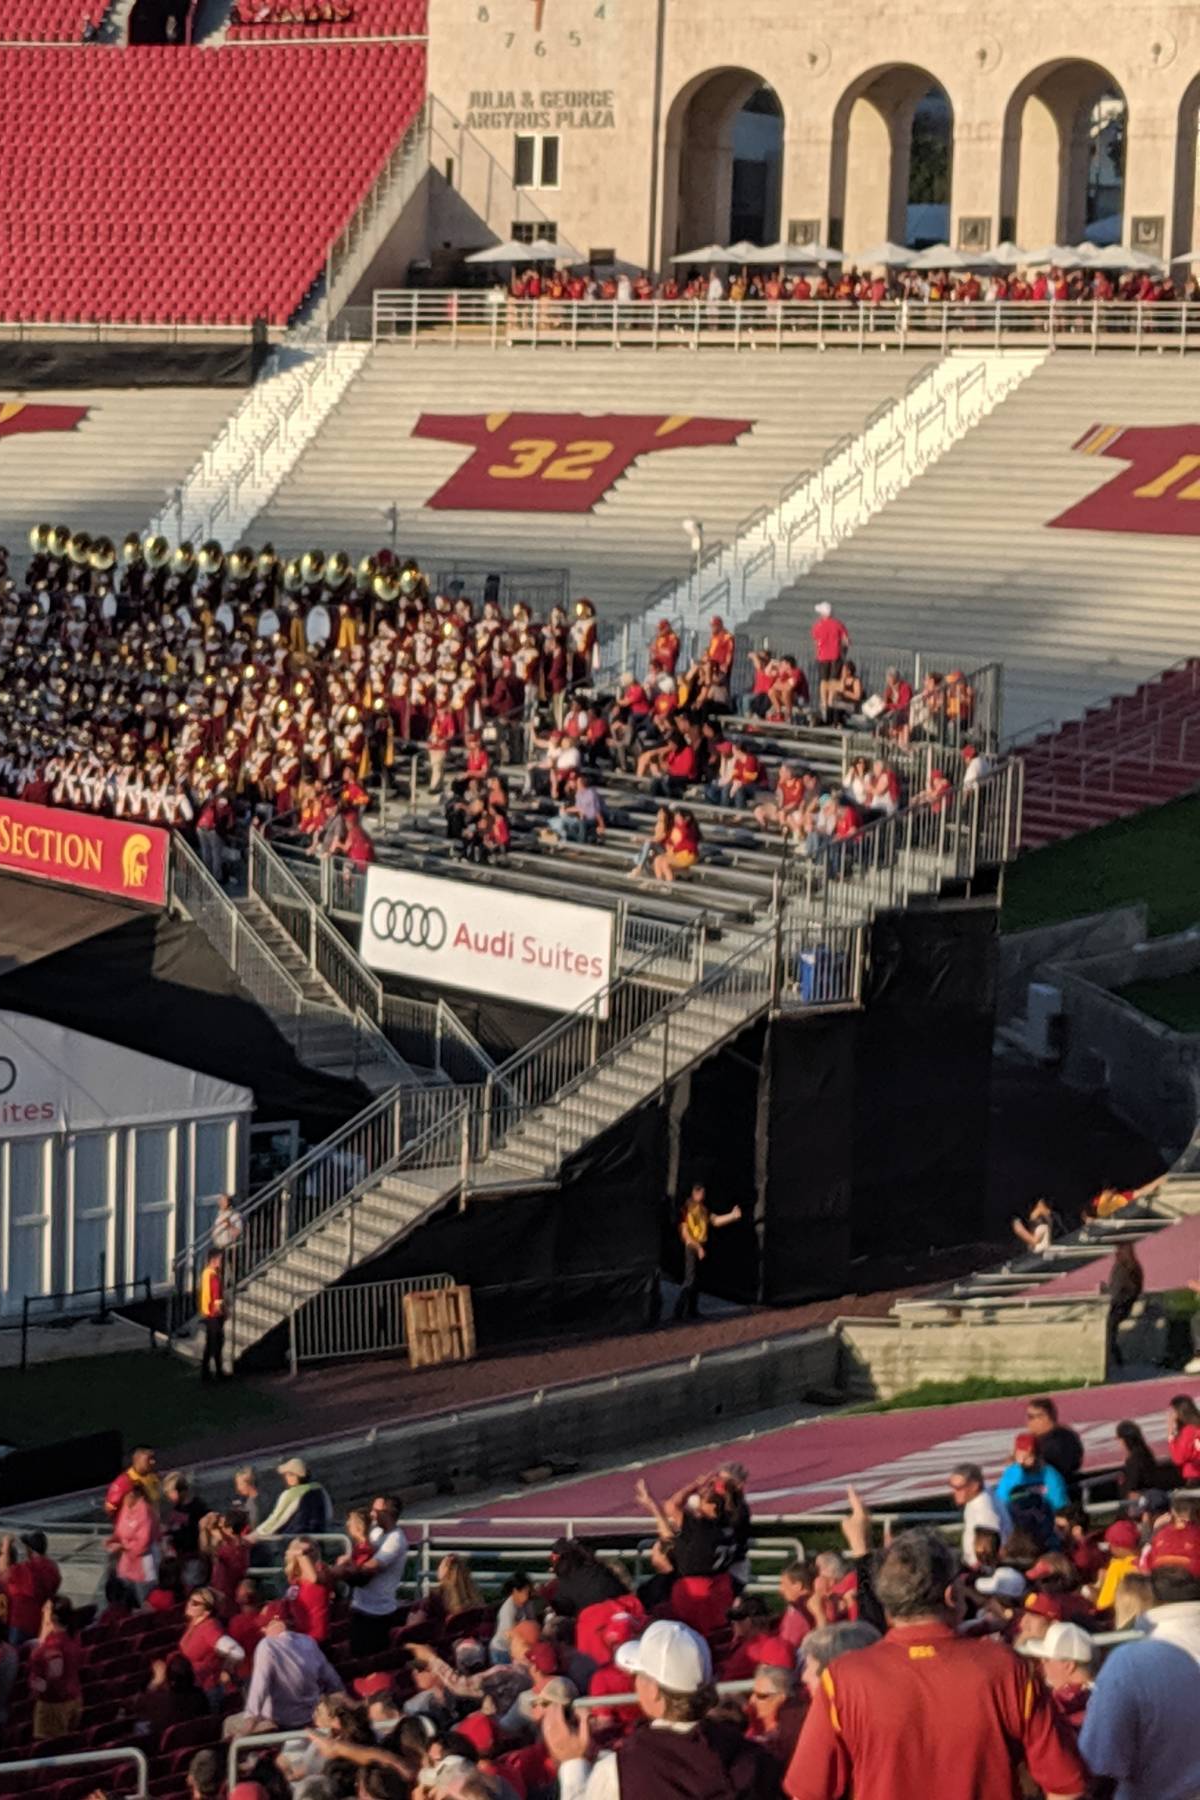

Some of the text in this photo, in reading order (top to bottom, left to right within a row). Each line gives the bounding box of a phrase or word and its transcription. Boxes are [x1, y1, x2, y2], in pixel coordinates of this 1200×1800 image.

[505, 32, 516, 48] 7
[534, 40, 547, 57] 6
[568, 31, 581, 47] 5
[467, 90, 615, 109] JULIA & GEORGE
[555, 110, 615, 129] PLAZA
[488, 439, 615, 480] 32
[452, 922, 604, 979] Audi Suites
